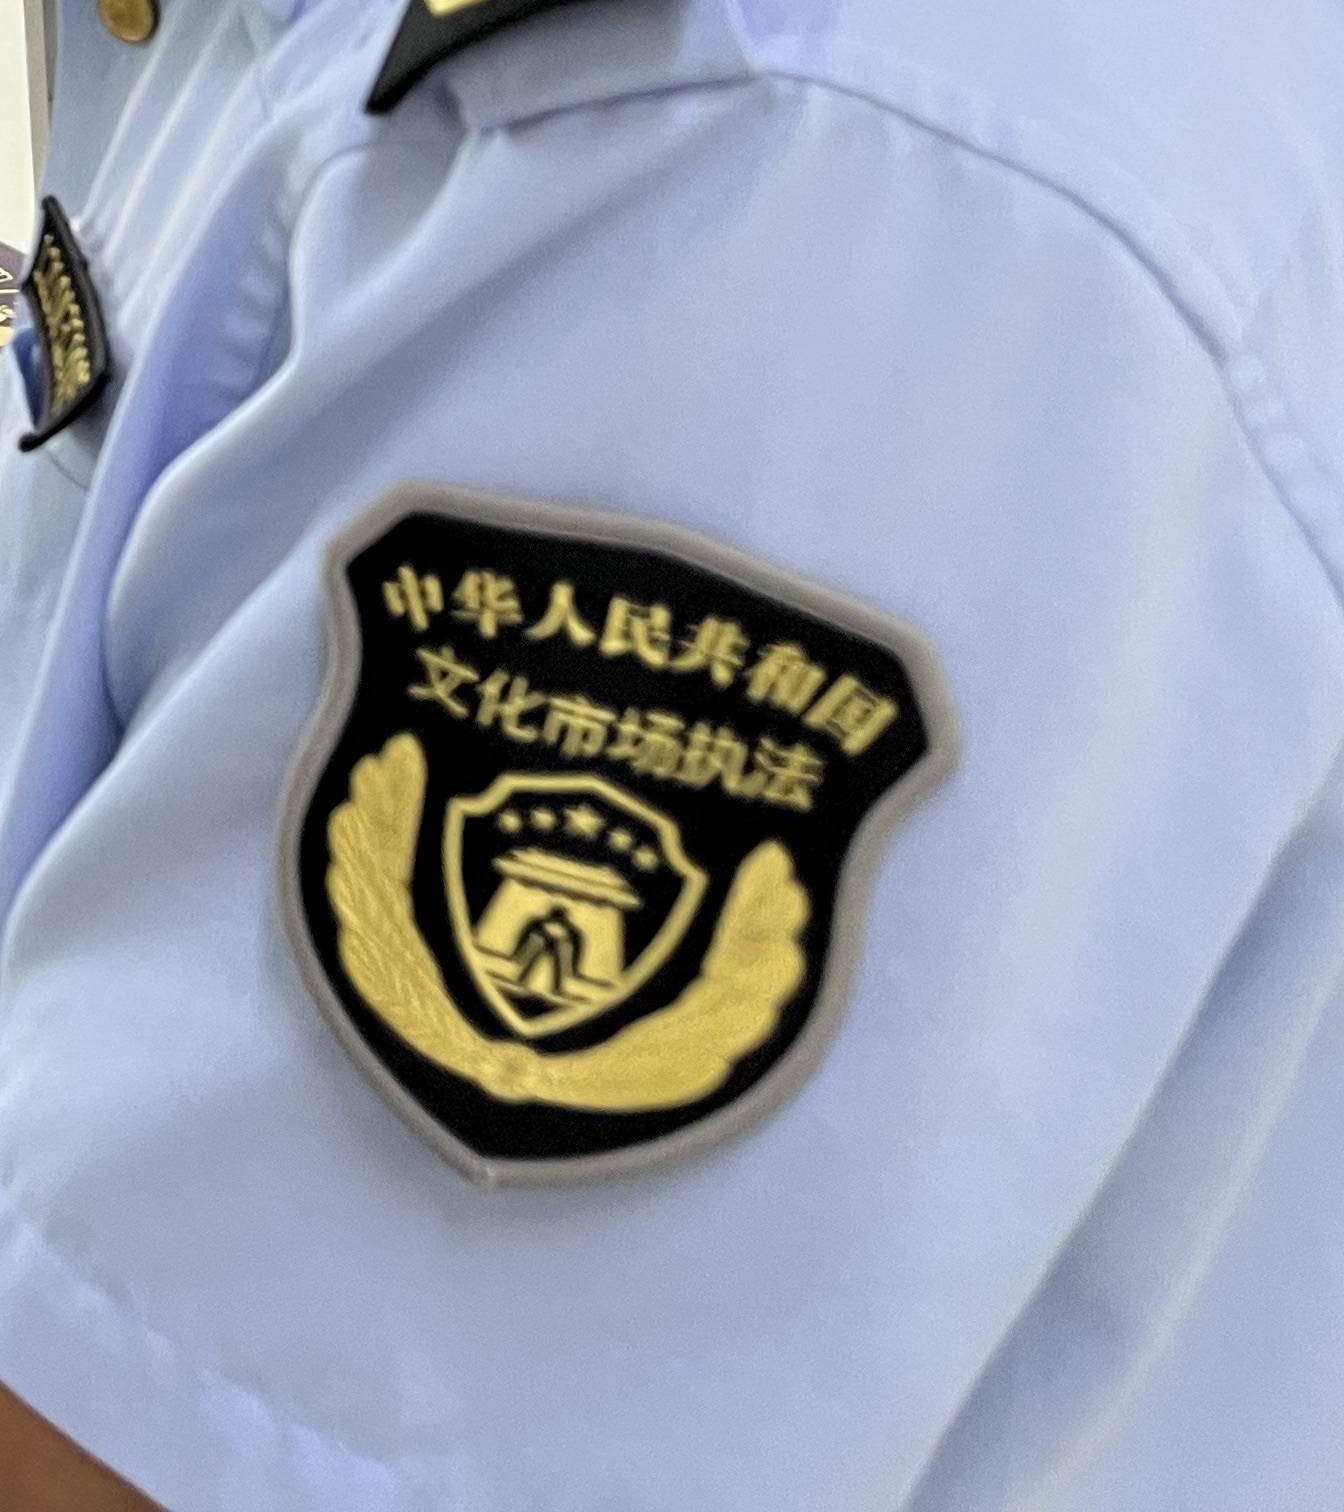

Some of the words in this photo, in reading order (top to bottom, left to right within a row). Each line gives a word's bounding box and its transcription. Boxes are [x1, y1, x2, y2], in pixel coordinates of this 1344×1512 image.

[382, 563, 899, 757] 中华人民共和国
[408, 643, 826, 813] 文化市场执法
